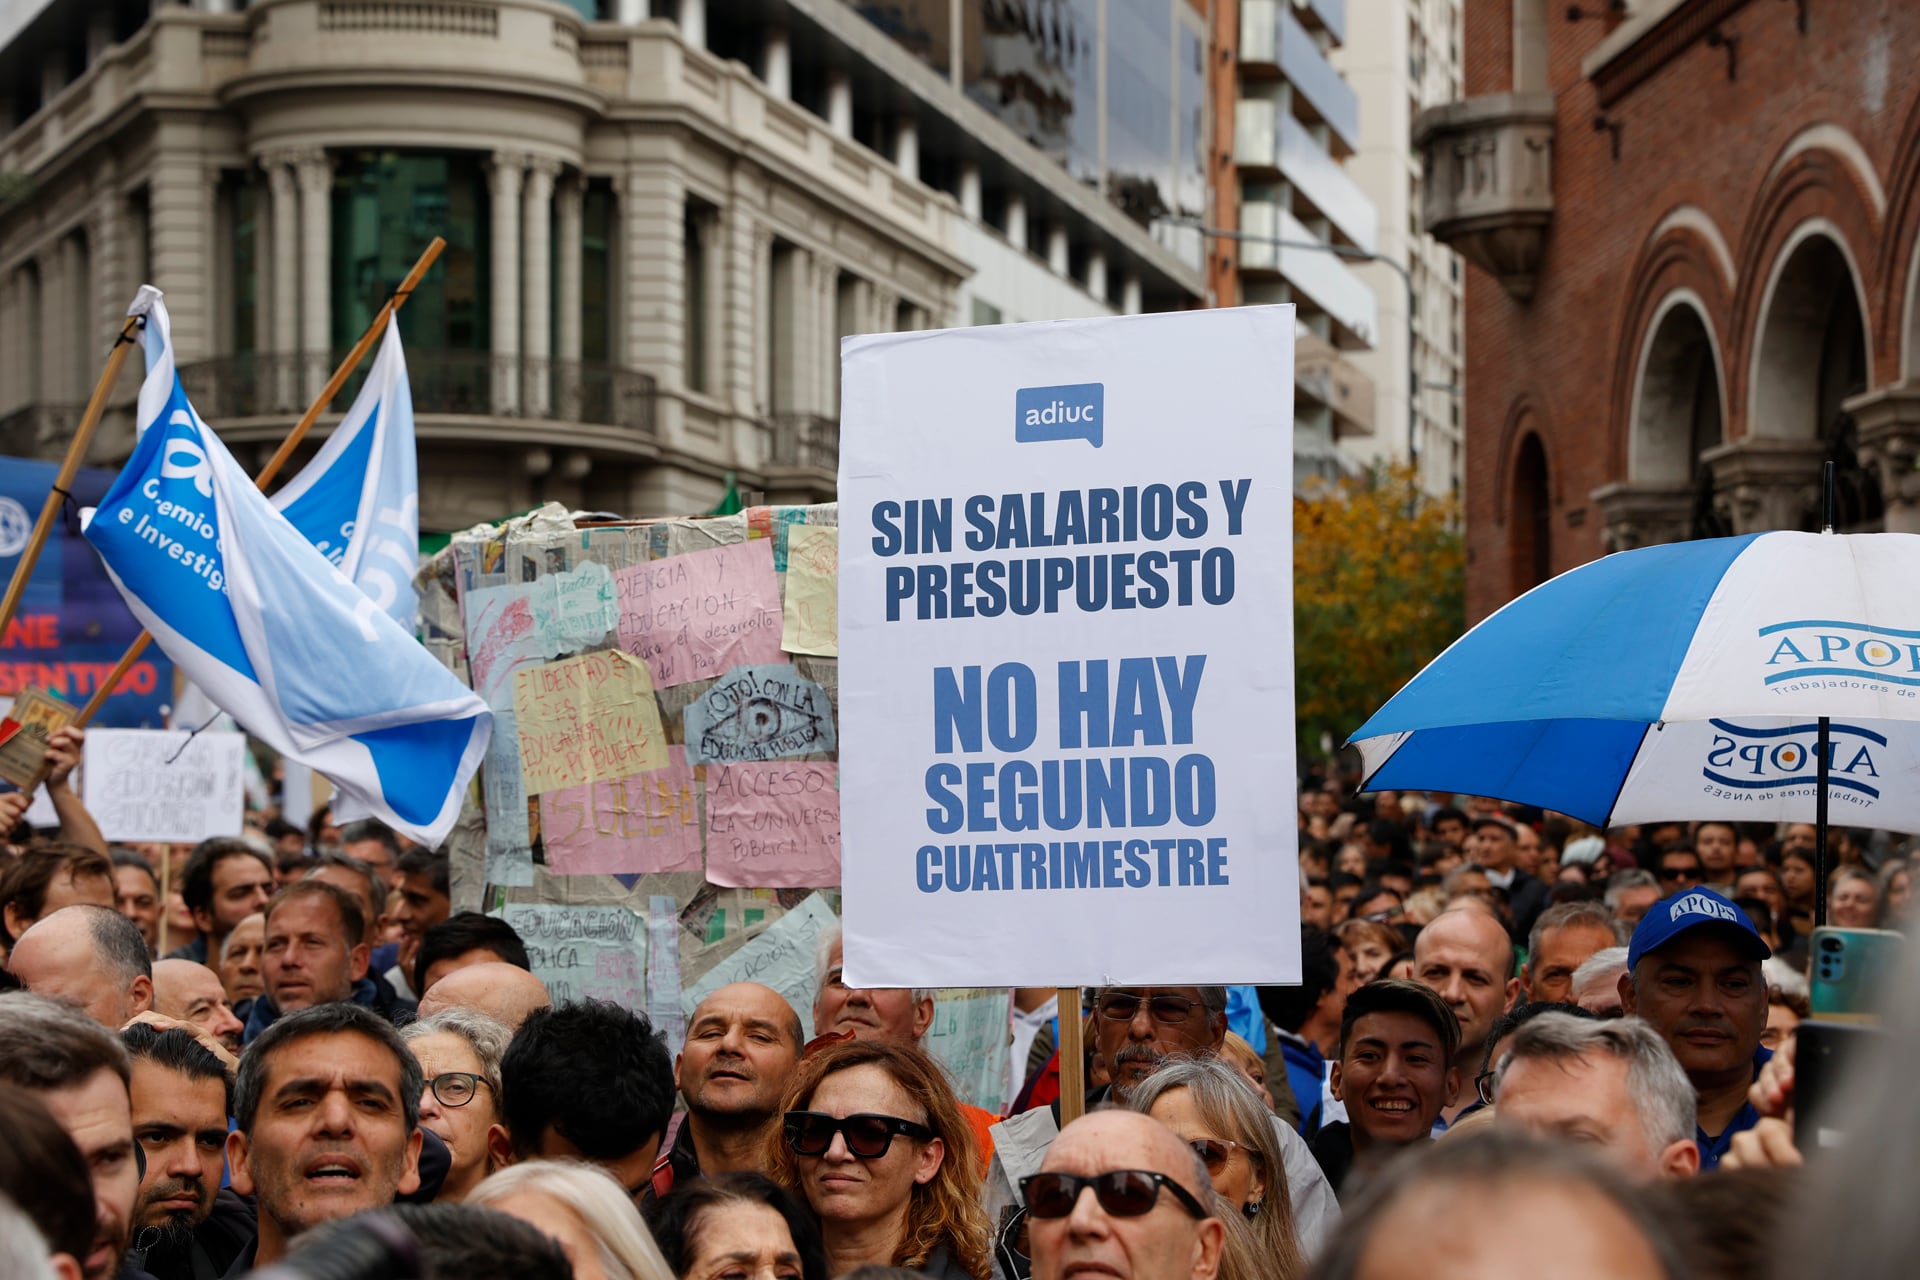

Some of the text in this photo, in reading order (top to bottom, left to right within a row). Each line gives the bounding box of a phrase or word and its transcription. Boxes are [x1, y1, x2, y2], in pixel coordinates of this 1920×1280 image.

[1025, 400, 1094, 426] adiuc
[118, 507, 134, 524] e
[872, 478, 1252, 557] SIN SALARIOS Y
[885, 546, 1236, 622] PRESUPUESTO
[677, 626, 687, 646] el
[705, 614, 773, 640] desarrollo
[659, 657, 674, 681] del
[794, 686, 815, 712] LA
[934, 654, 1207, 753] NO HAY
[1771, 680, 1916, 698] Trabajadores de
[715, 765, 825, 797] ACCESO
[925, 753, 1216, 834] SEGUNDO
[711, 807, 839, 833] LA UNIVERS
[916, 838, 1229, 893] CUATRIMESTRE
[1674, 896, 1736, 922] APOPS
